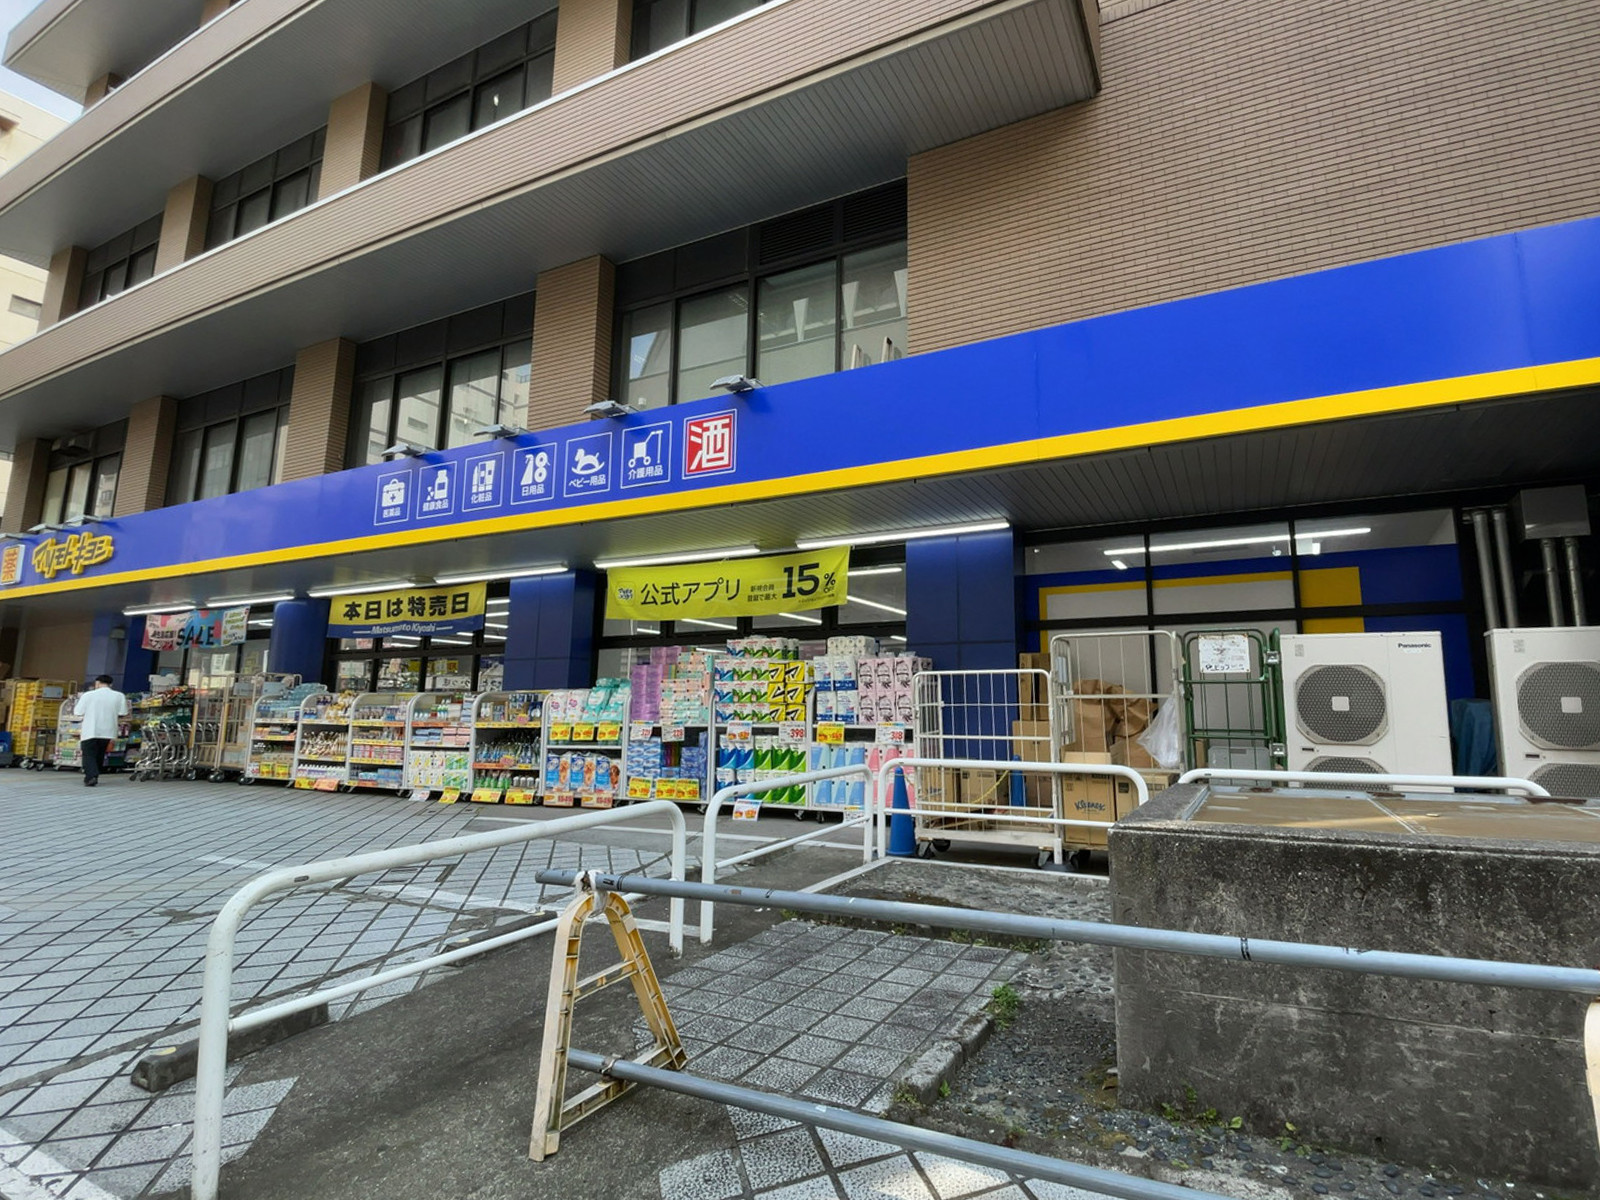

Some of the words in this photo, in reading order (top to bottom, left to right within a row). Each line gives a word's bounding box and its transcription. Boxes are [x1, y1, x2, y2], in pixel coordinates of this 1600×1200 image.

[689, 417, 730, 471] 酒
[627, 464, 664, 481] 介護用品
[520, 482, 546, 497] 日用品
[567, 474, 607, 489] ベビー用品
[422, 498, 450, 512] 健康食品
[470, 491, 493, 505] 化粧品
[32, 532, 114, 579] マツモトキヨシ
[640, 576, 741, 606] 公式アプリ
[343, 592, 470, 621] 本日は特売日
[176, 625, 216, 647] SALE
[370, 624, 411, 635] Matsumoto
[411, 622, 437, 634] Kiyoshi
